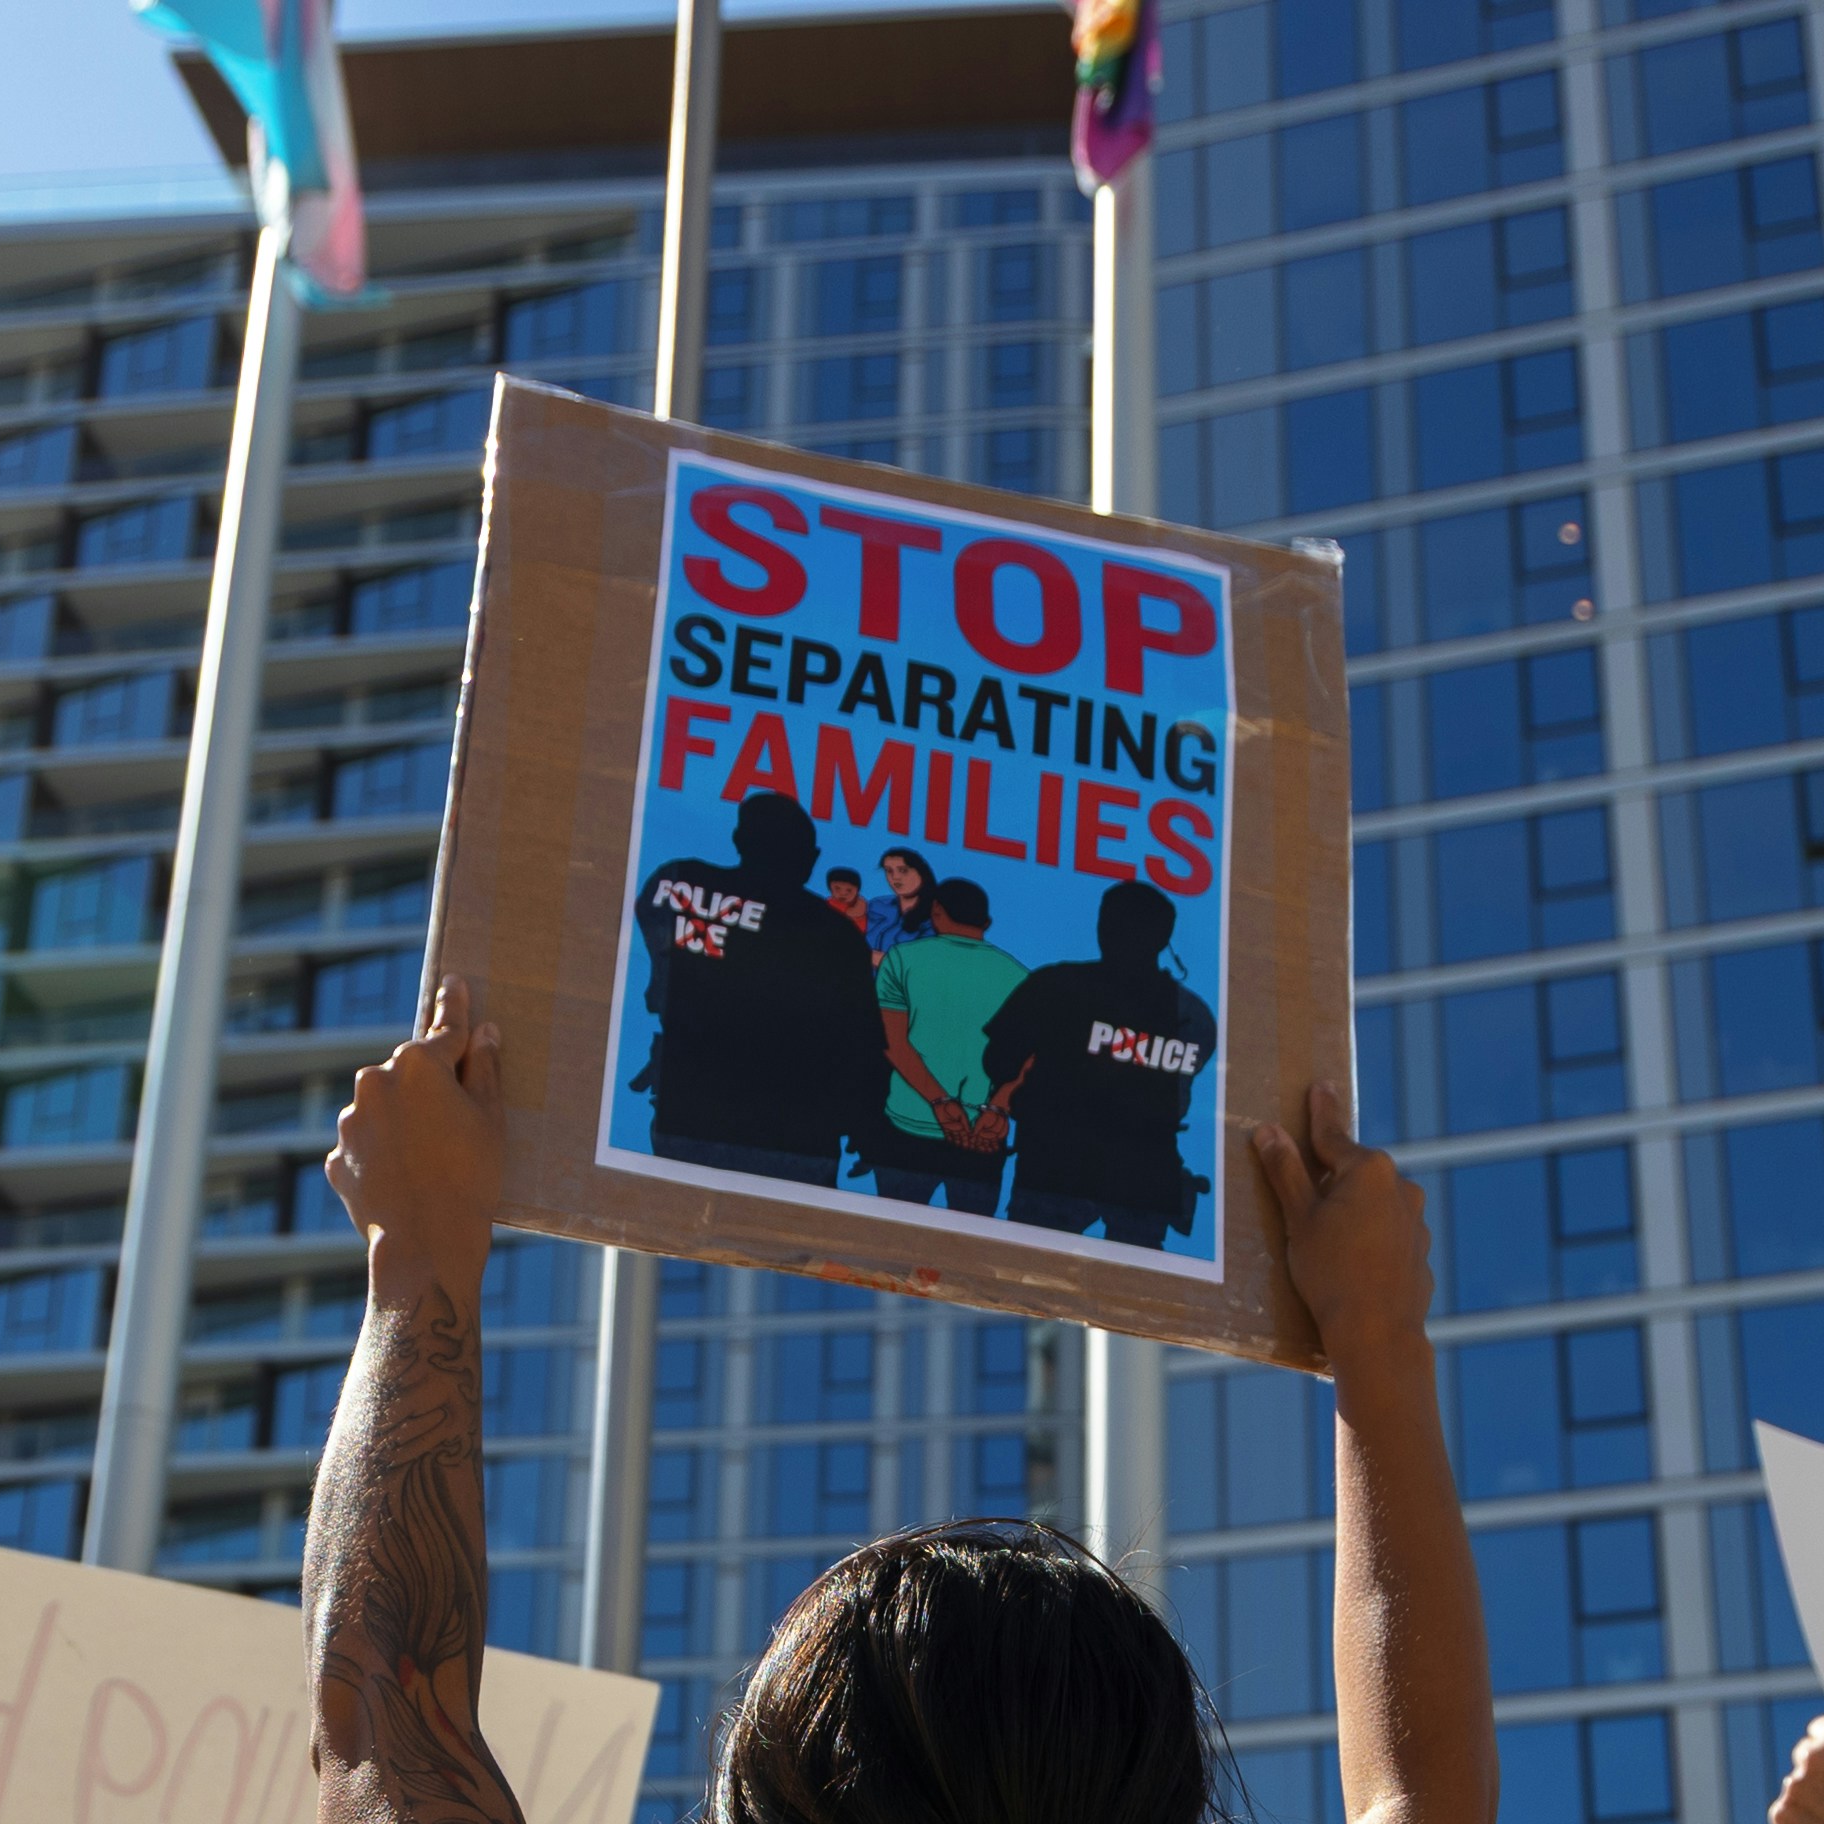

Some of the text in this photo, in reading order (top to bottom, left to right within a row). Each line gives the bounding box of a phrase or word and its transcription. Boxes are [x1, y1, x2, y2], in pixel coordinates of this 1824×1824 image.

[682, 483, 1217, 695] STOP
[668, 612, 1217, 796] SEPARATING
[657, 695, 1214, 896] FAMILIES
[652, 879, 766, 932] POLICE
[676, 915, 728, 958] ICE
[1087, 1020, 1200, 1075] POLICE
